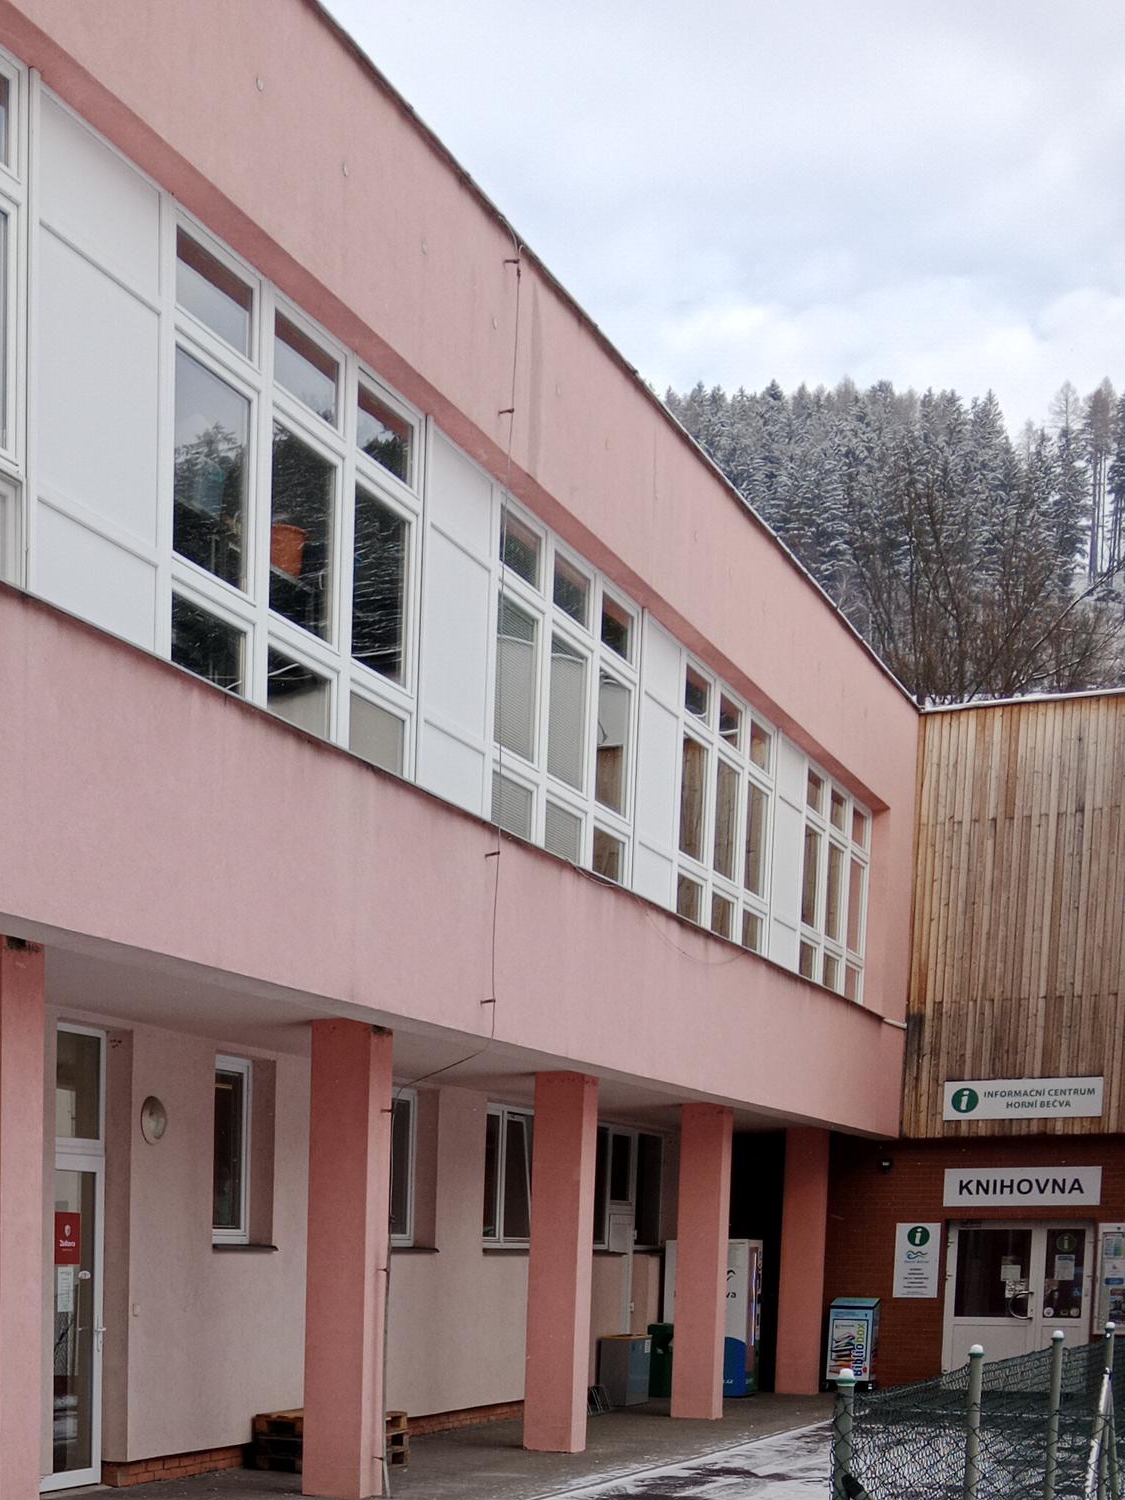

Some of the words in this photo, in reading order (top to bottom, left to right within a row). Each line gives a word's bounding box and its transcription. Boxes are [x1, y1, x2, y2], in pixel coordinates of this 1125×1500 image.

[983, 1087, 1046, 1098] INFORMAČNÍ
[1047, 1087, 1096, 1097] CENTRUM
[1005, 1099, 1038, 1109] HORNÍ
[1040, 1098, 1071, 1109] BEČVA
[958, 1178, 1085, 1196] KNIHOVNA
